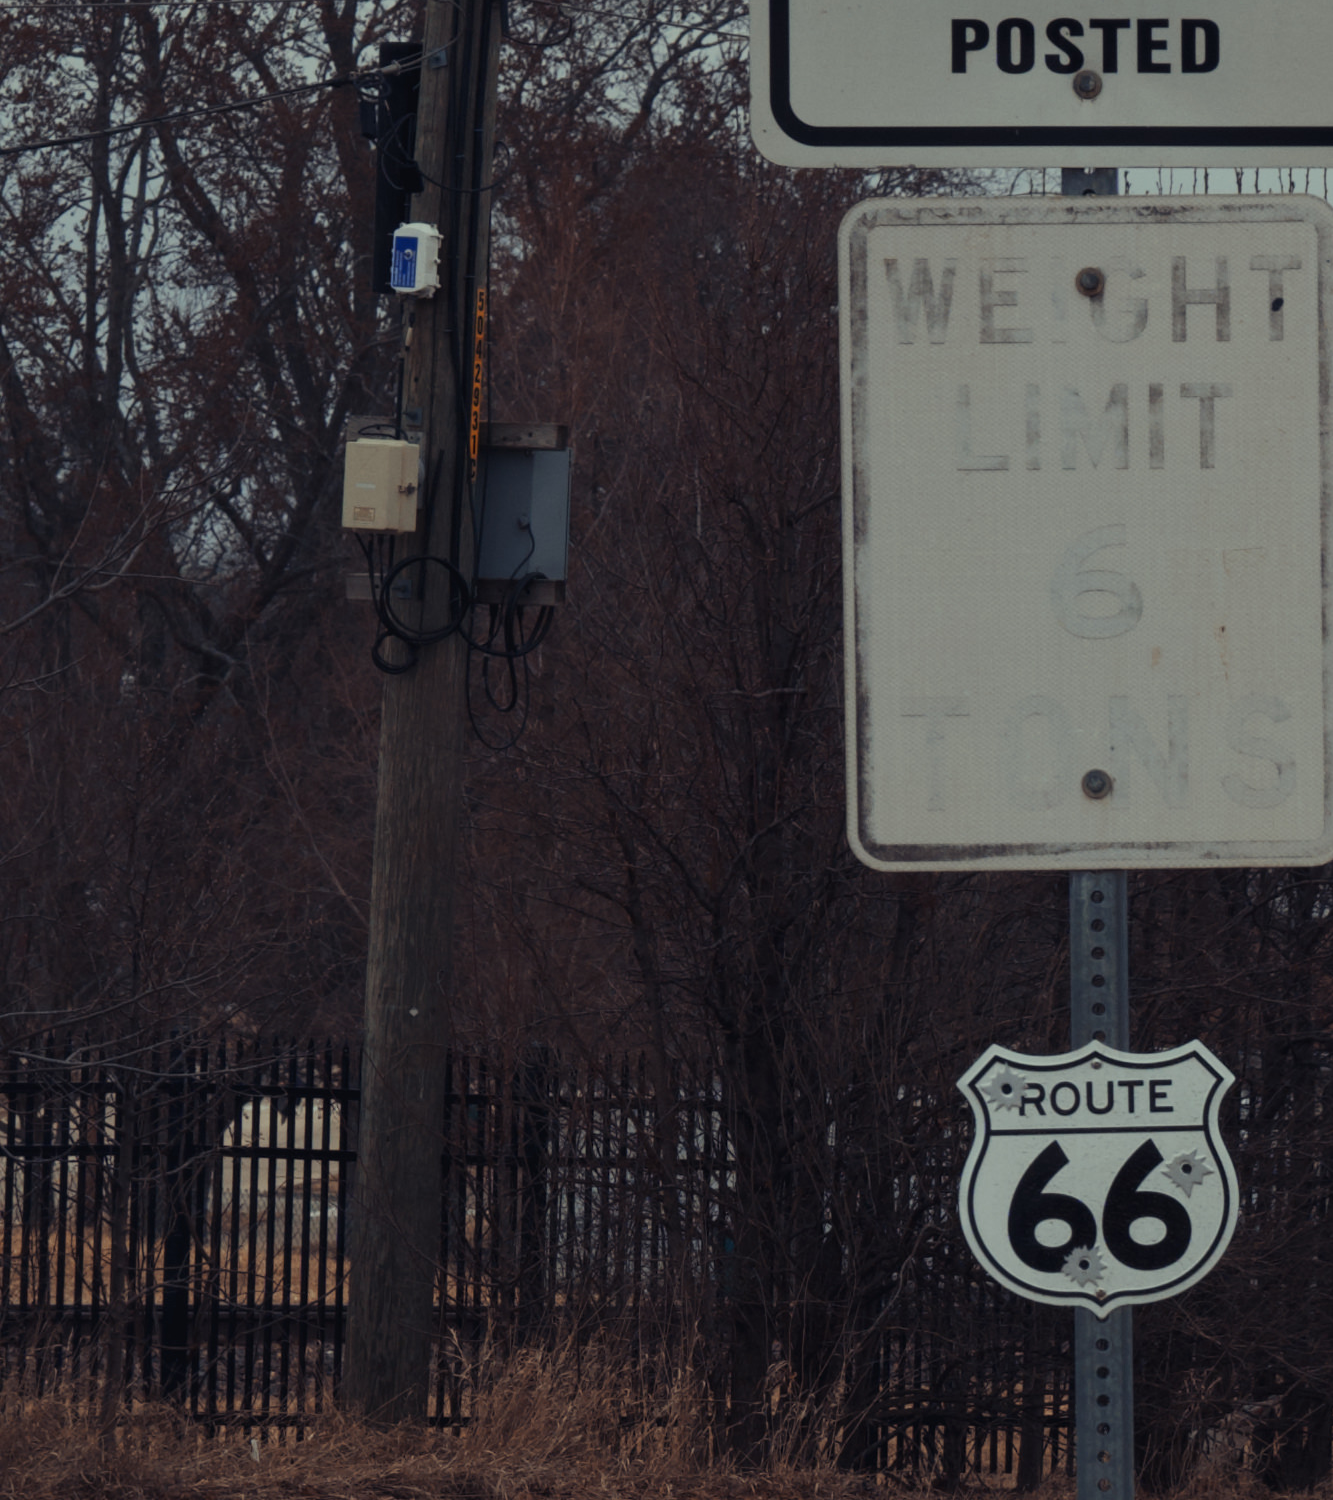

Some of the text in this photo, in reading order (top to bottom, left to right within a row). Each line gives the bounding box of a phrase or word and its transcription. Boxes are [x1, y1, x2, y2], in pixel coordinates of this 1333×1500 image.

[951, 17, 1221, 74] POSTED
[883, 254, 1302, 344] WEIGHT
[956, 382, 1232, 470] LIMIT
[1050, 523, 1144, 640] 6
[900, 694, 1297, 813] TONS
[1018, 1078, 1174, 1116] ROUTE
[1007, 1138, 1192, 1273] 66
